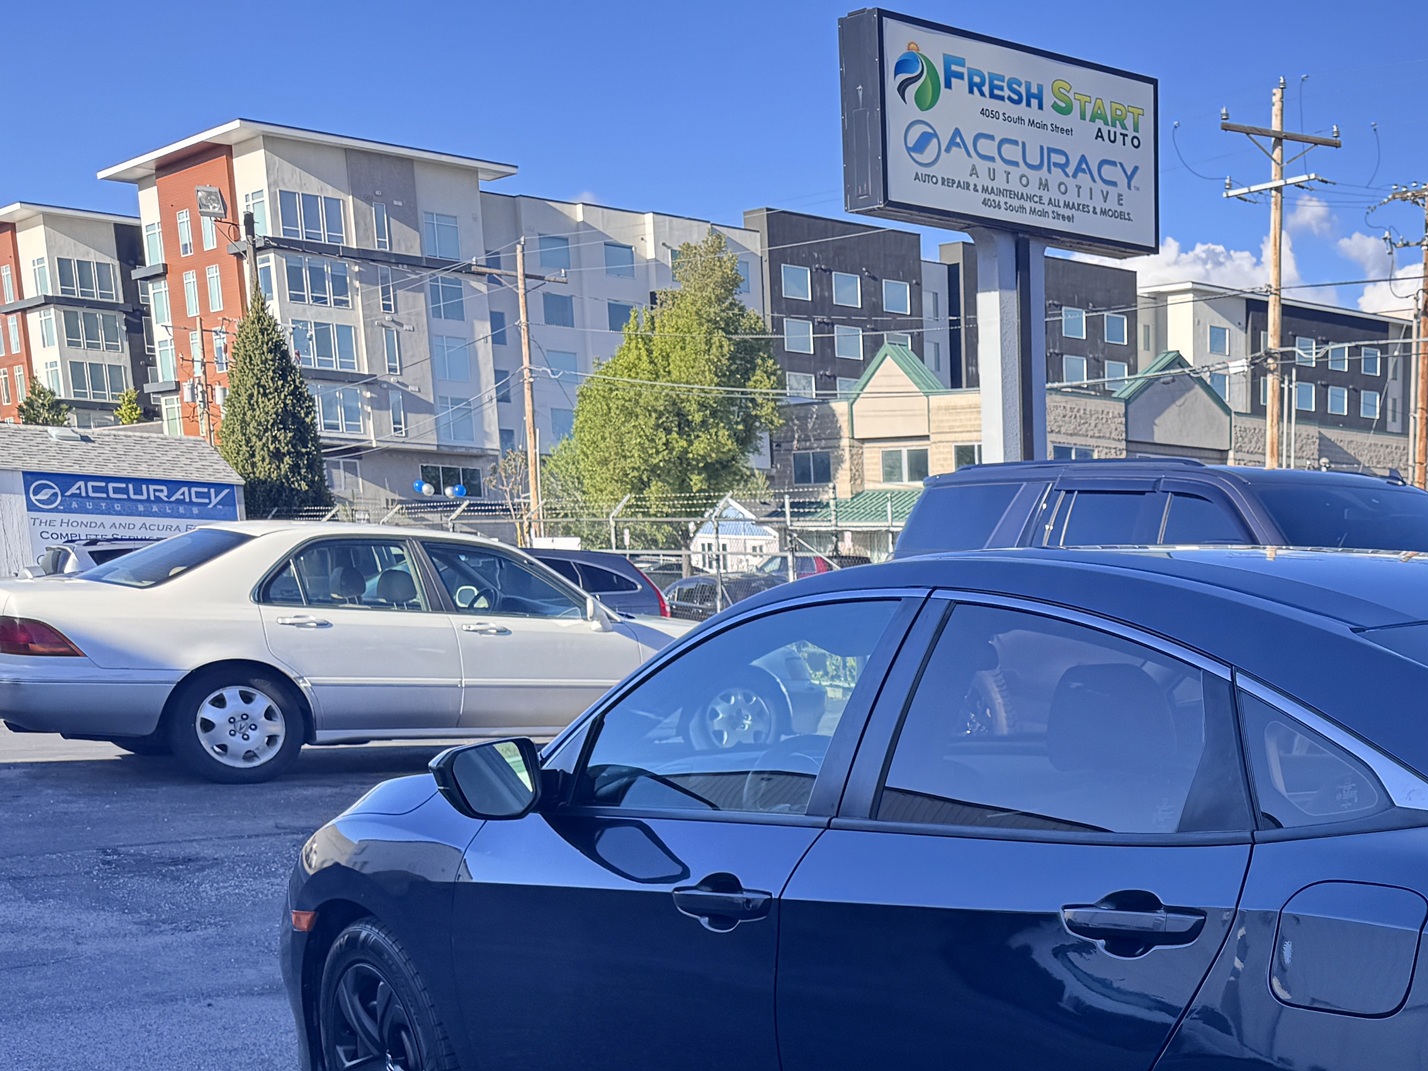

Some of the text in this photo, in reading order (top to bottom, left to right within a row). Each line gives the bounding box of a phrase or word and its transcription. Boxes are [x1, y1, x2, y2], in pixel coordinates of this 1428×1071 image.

[943, 53, 1145, 133] FRESH START
[980, 107, 1073, 136] 4050 South Main Street
[1094, 127, 1141, 149] AUTO
[944, 127, 1140, 191] ACCURACY
[913, 171, 939, 185] AUTO
[941, 176, 971, 192] REPAIR
[972, 183, 979, 193] &
[1047, 197, 1061, 208] ALL
[1063, 200, 1090, 214] MAKES
[1092, 206, 1098, 215] &
[1099, 207, 1133, 222] MODELS.
[969, 163, 1124, 207] AUTOMOTIVE
[981, 197, 1075, 223] 4036 South Main Street
[64, 480, 230, 509] ACCURACY
[71, 501, 122, 511] AUTO
[31, 517, 57, 527] THE
[60, 519, 106, 529] HONDA
[109, 522, 136, 530] AND
[138, 522, 181, 532] ACURA
